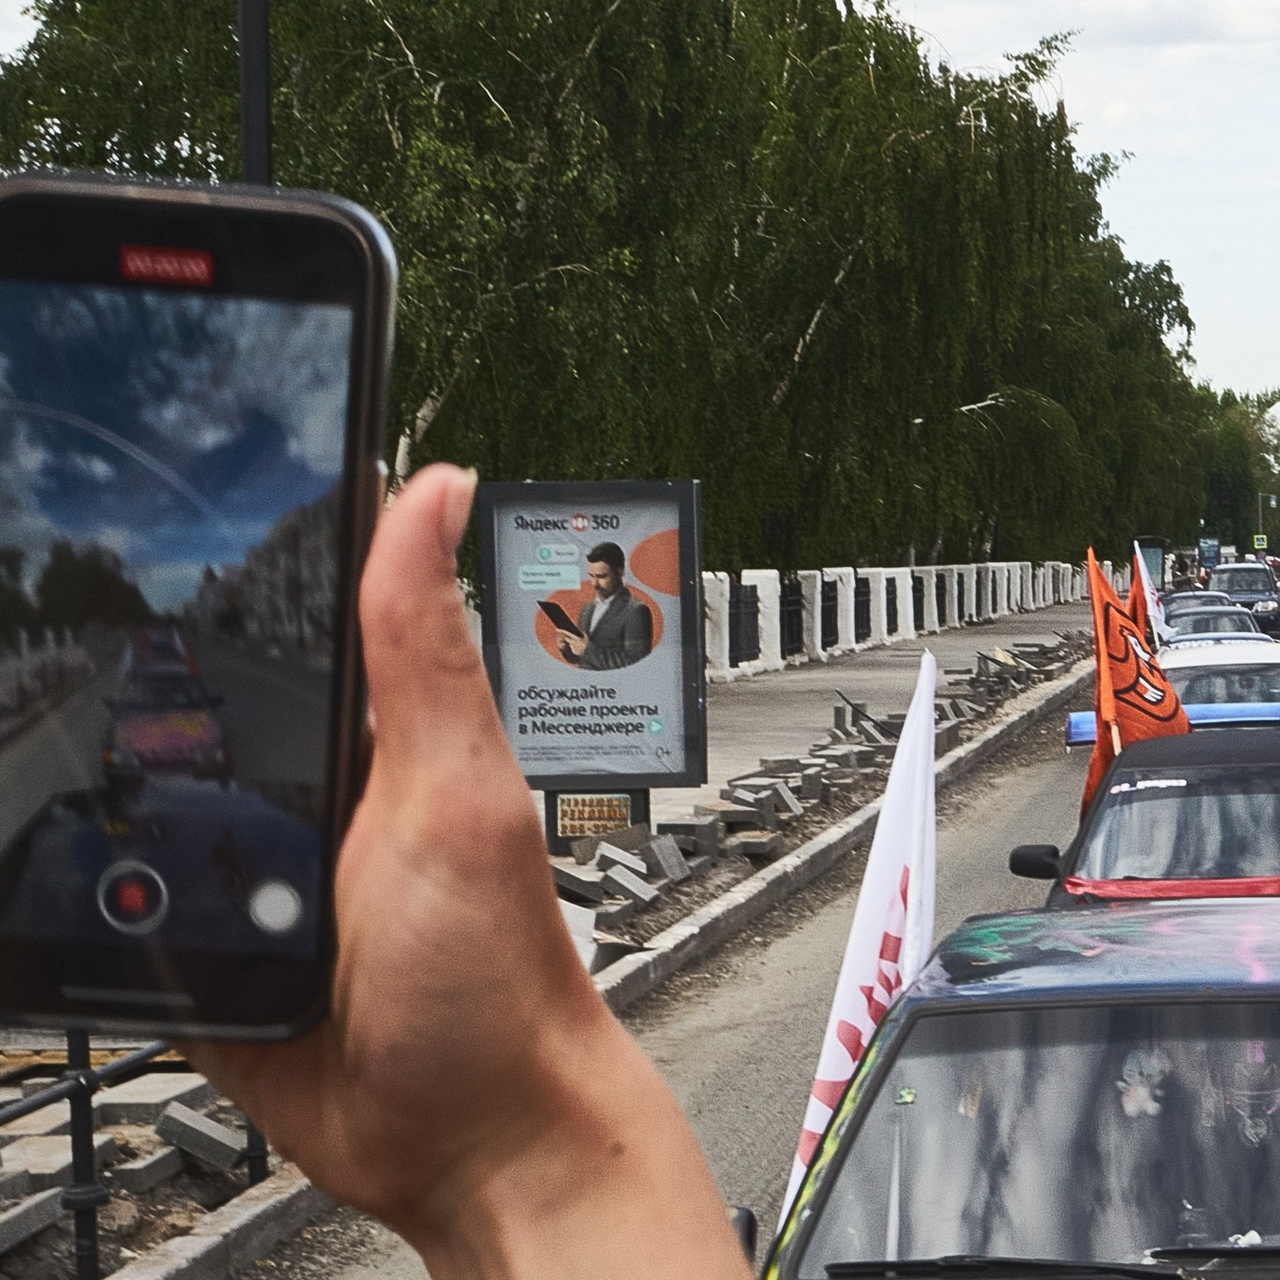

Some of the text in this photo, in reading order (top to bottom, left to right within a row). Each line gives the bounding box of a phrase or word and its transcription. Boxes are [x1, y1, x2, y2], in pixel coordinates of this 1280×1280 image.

[514, 514, 621, 532] Яндекс 360
[518, 685, 616, 702] обсуждайте
[518, 703, 659, 720] рабочие проекты
[519, 720, 645, 736] в Мессенджере
[656, 747, 671, 758] 0+
